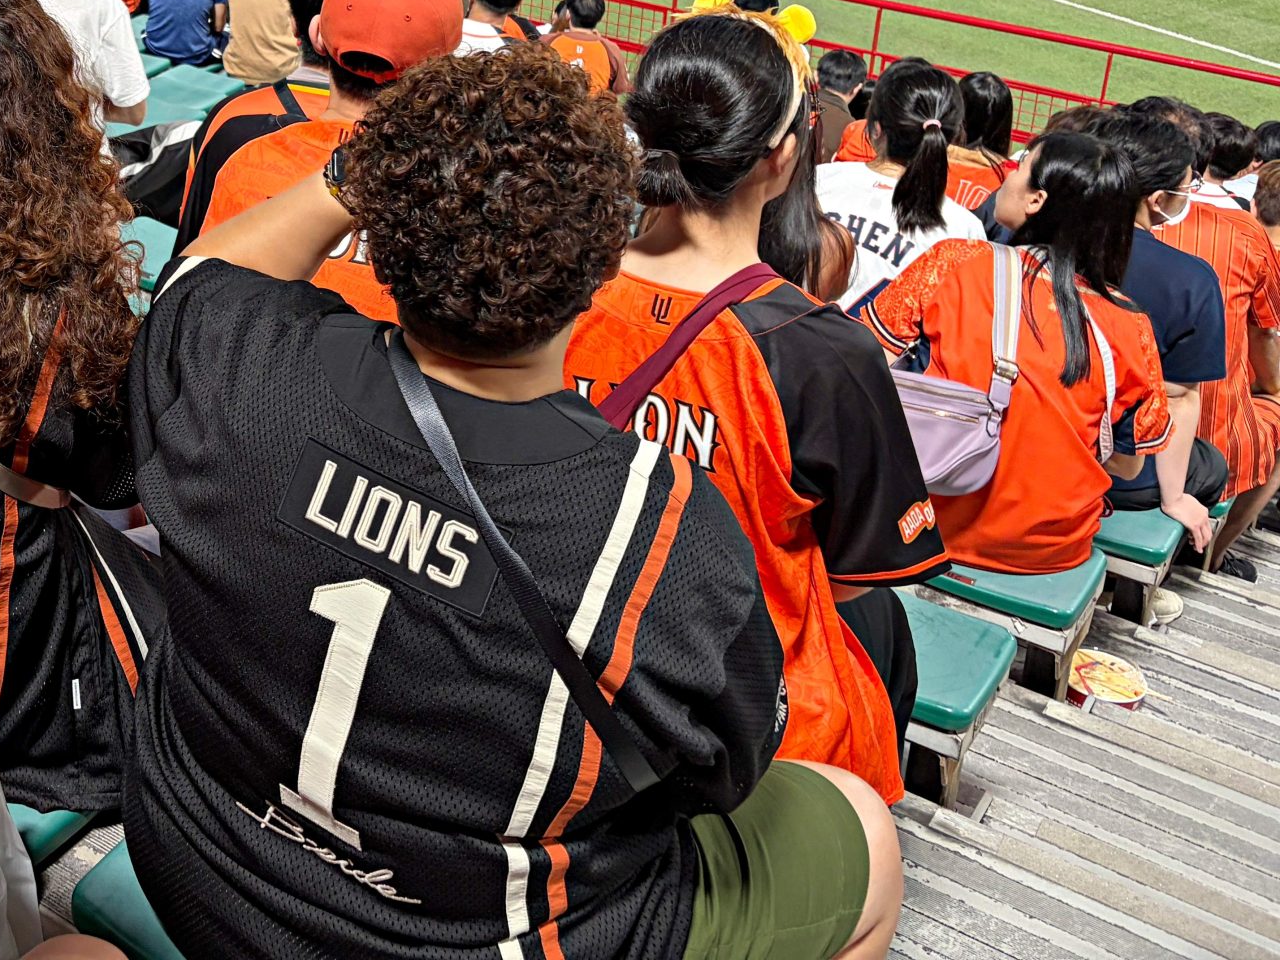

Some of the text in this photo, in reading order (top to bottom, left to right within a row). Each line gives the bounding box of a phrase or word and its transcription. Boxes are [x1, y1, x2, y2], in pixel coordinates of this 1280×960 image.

[573, 375, 722, 473] ON
[304, 459, 480, 589] LIONS
[278, 577, 392, 852] 1
